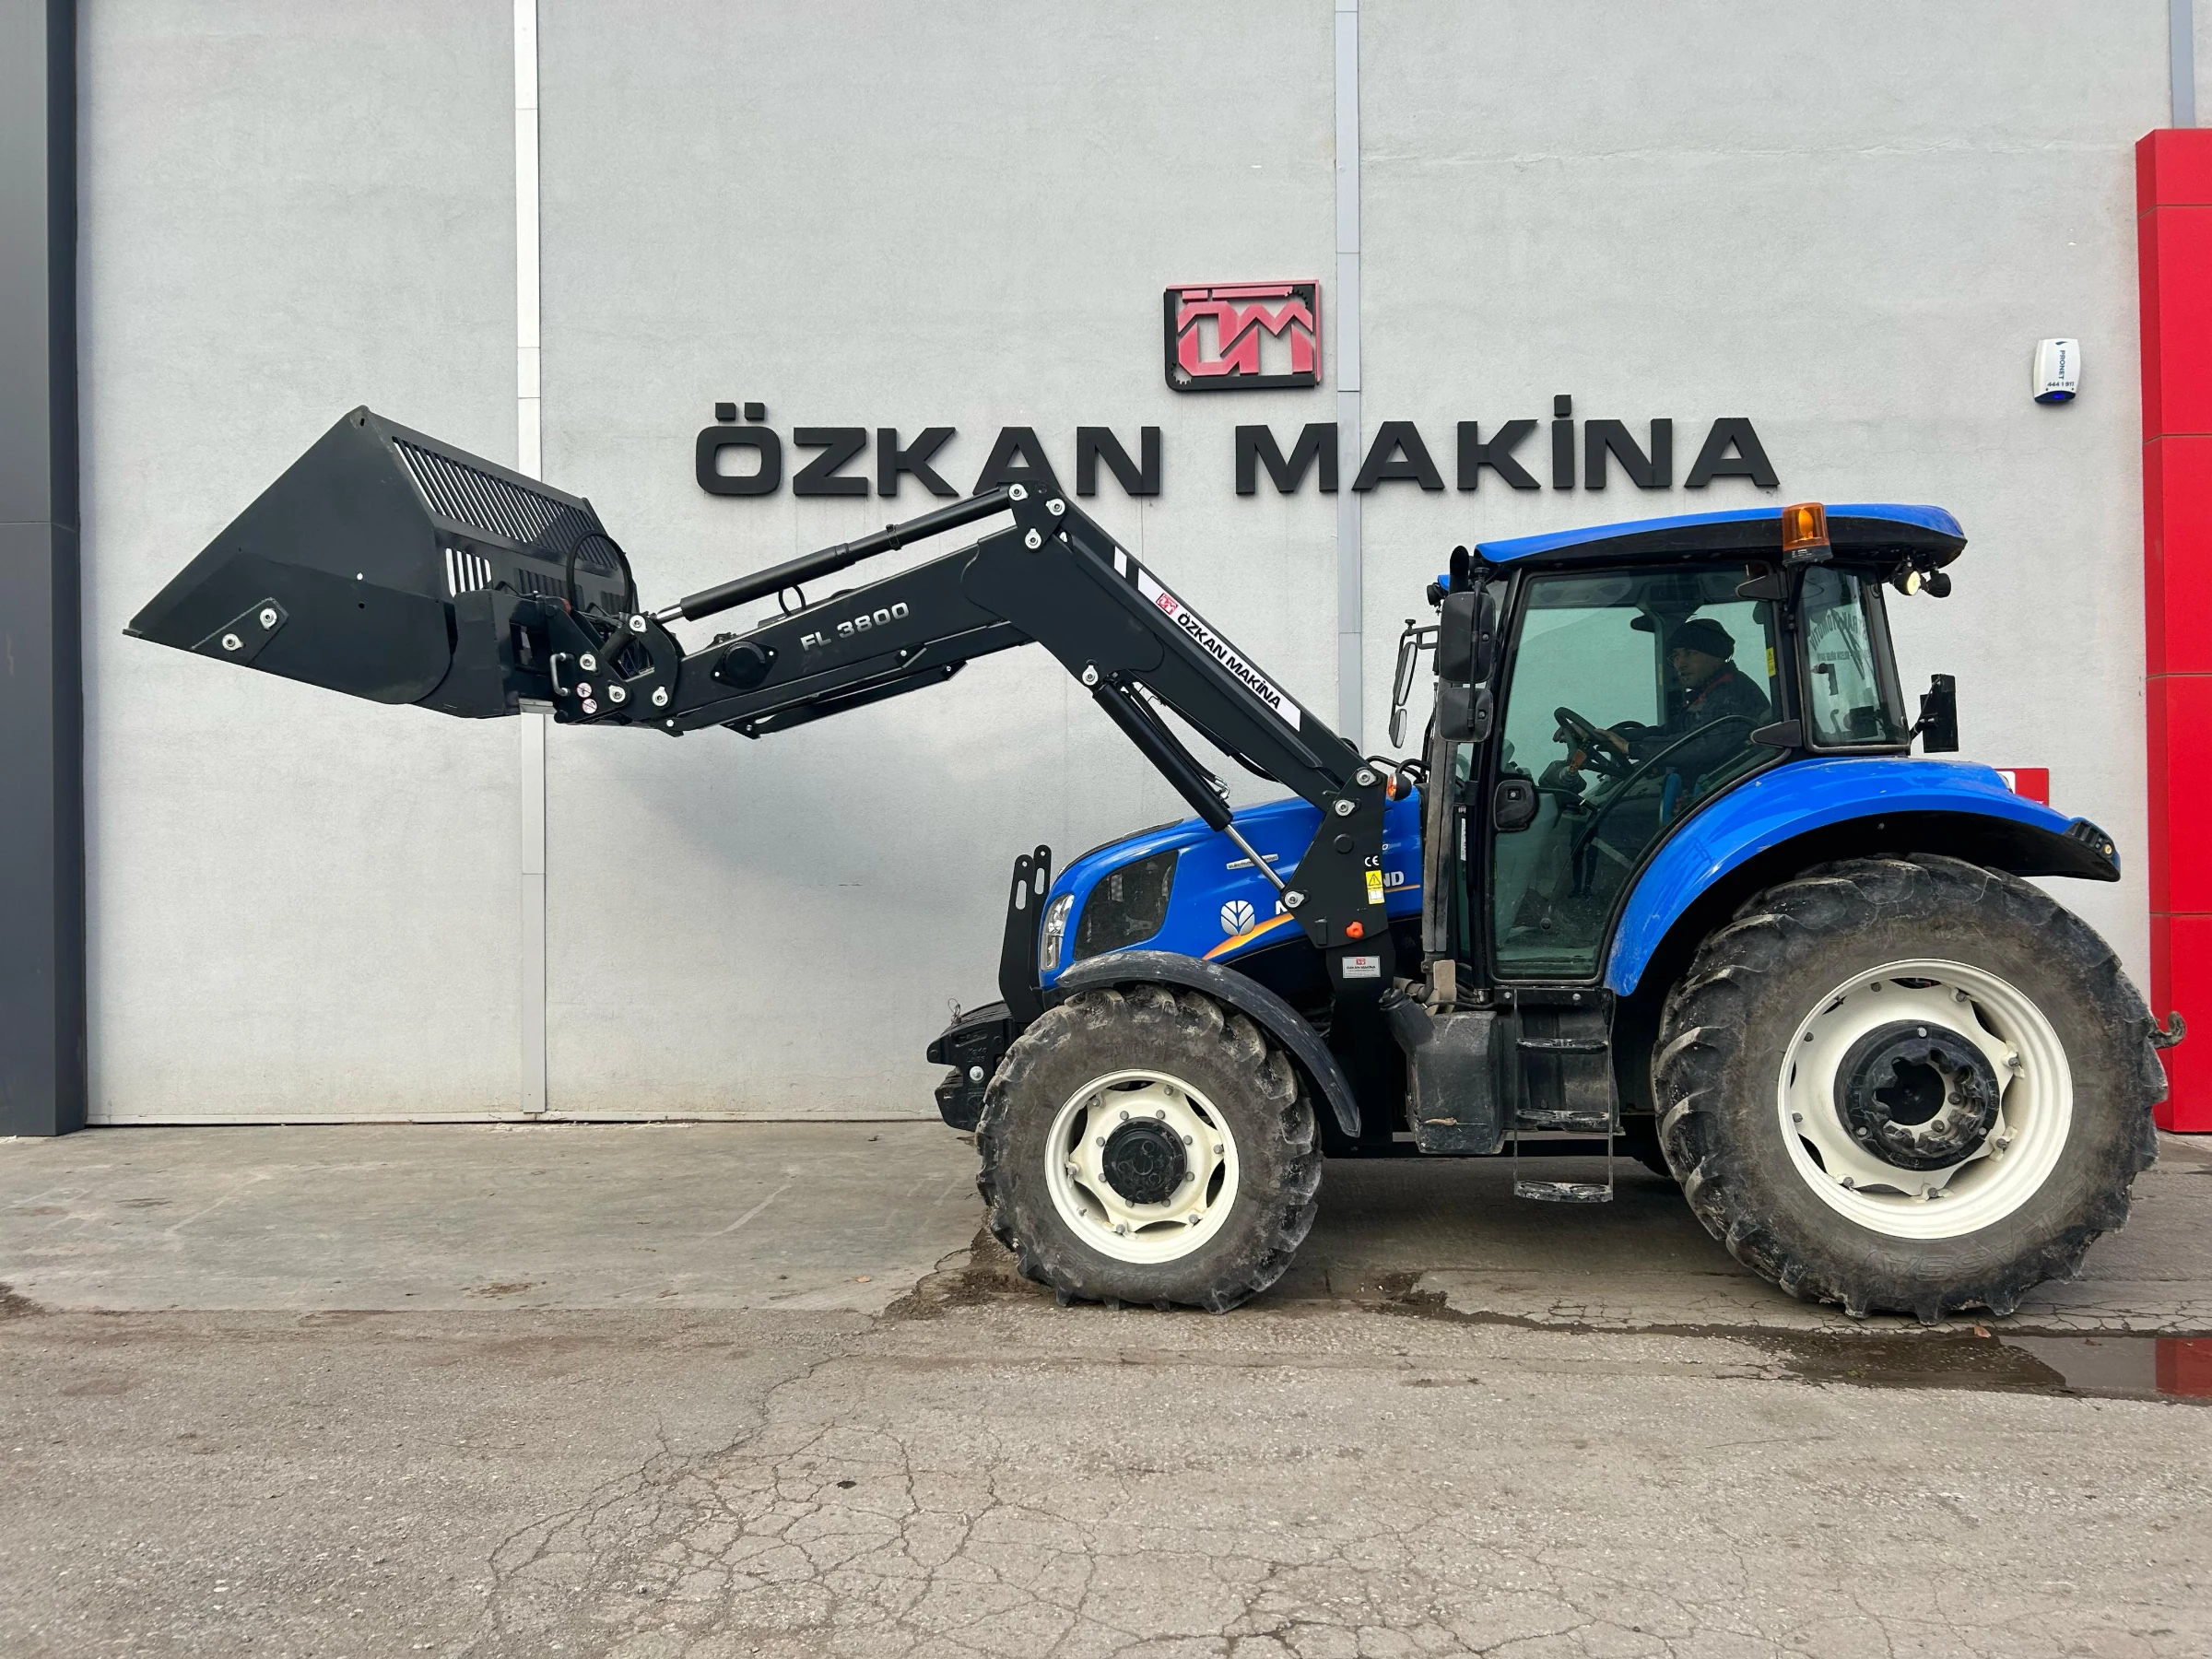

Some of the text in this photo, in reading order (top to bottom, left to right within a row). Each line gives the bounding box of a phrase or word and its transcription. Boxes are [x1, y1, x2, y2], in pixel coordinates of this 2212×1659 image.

[695, 394, 1781, 497] ÖZKAN MAKİNA
[800, 602, 910, 652] FL 3800
[1177, 612, 1281, 710] ÖZKAN MAKİNA
[1364, 855, 1380, 867] CE
